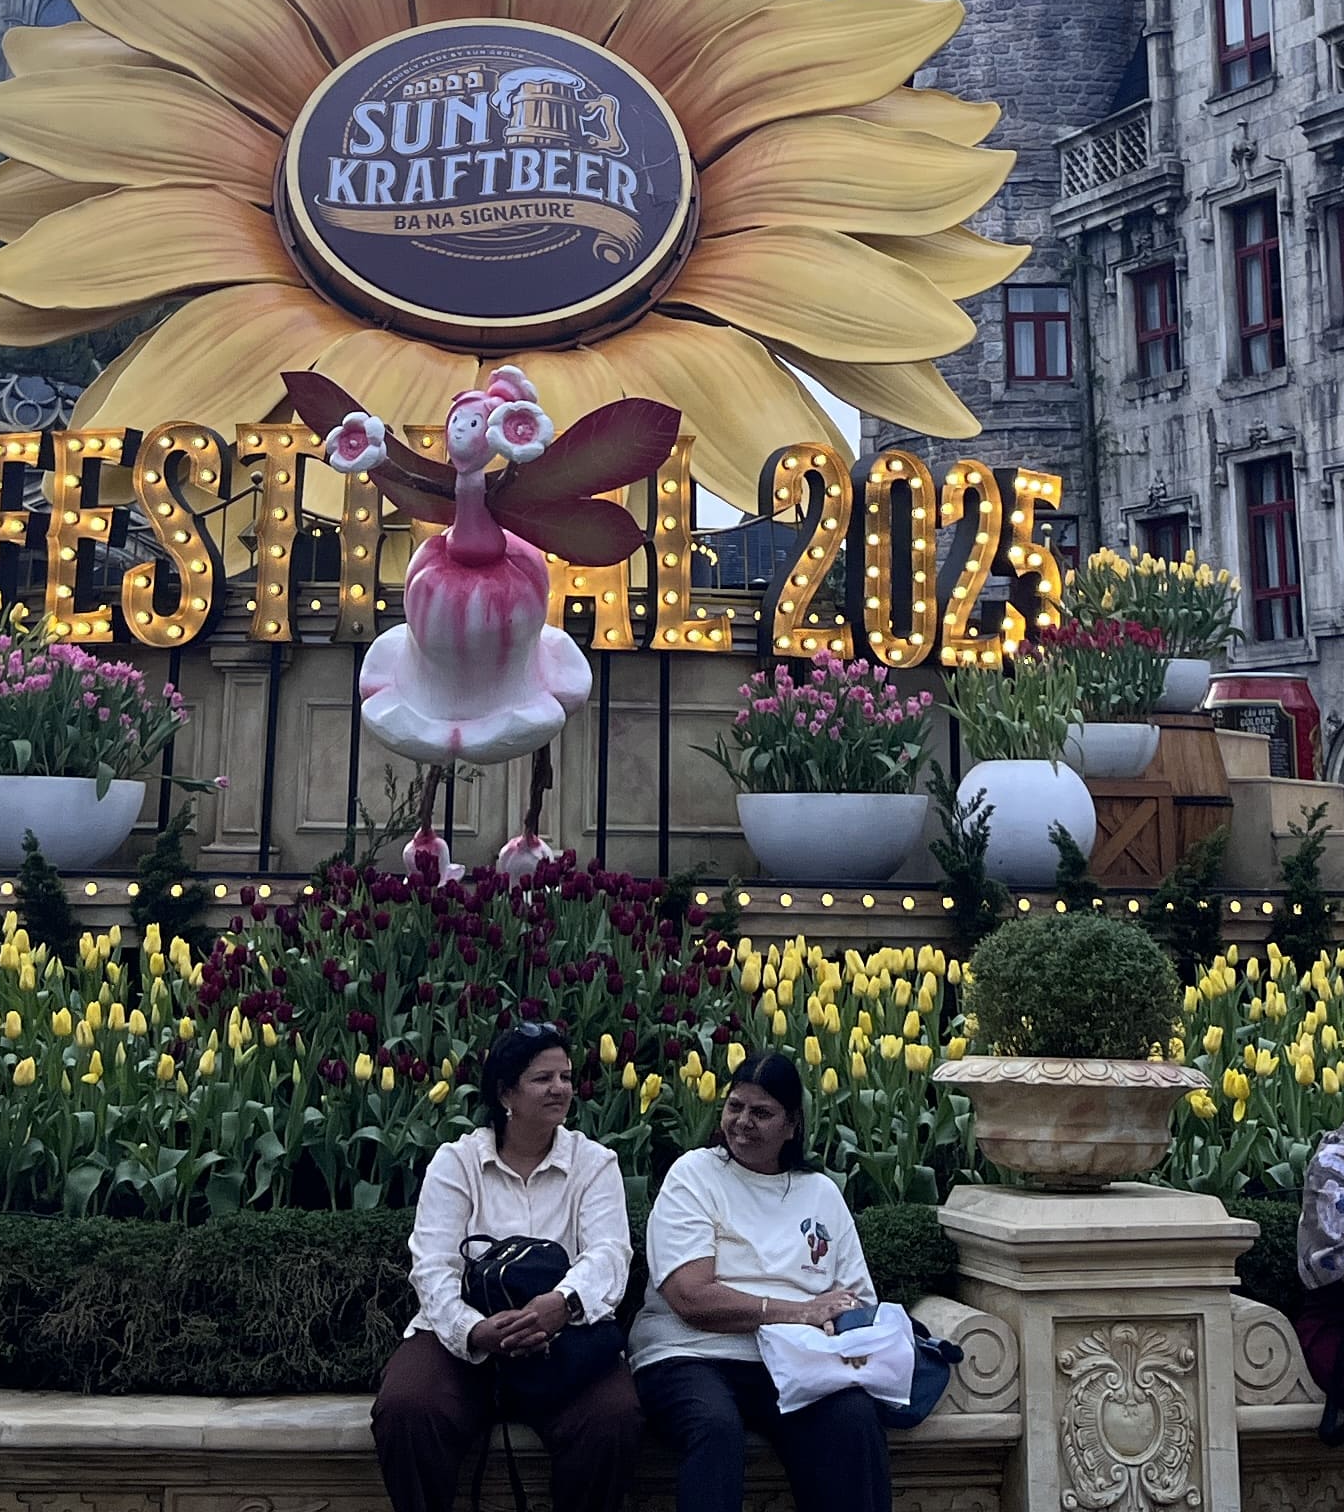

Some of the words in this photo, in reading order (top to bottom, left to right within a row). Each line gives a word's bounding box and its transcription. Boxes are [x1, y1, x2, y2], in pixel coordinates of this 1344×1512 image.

[349, 91, 492, 156] SUN
[325, 147, 641, 215] KRAFTBEER
[393, 215, 421, 230] BA
[426, 213, 455, 230] NA
[460, 202, 575, 226] SIGNATURE
[762, 441, 1063, 668] 2025
[1240, 717, 1271, 727] GOLDEN
